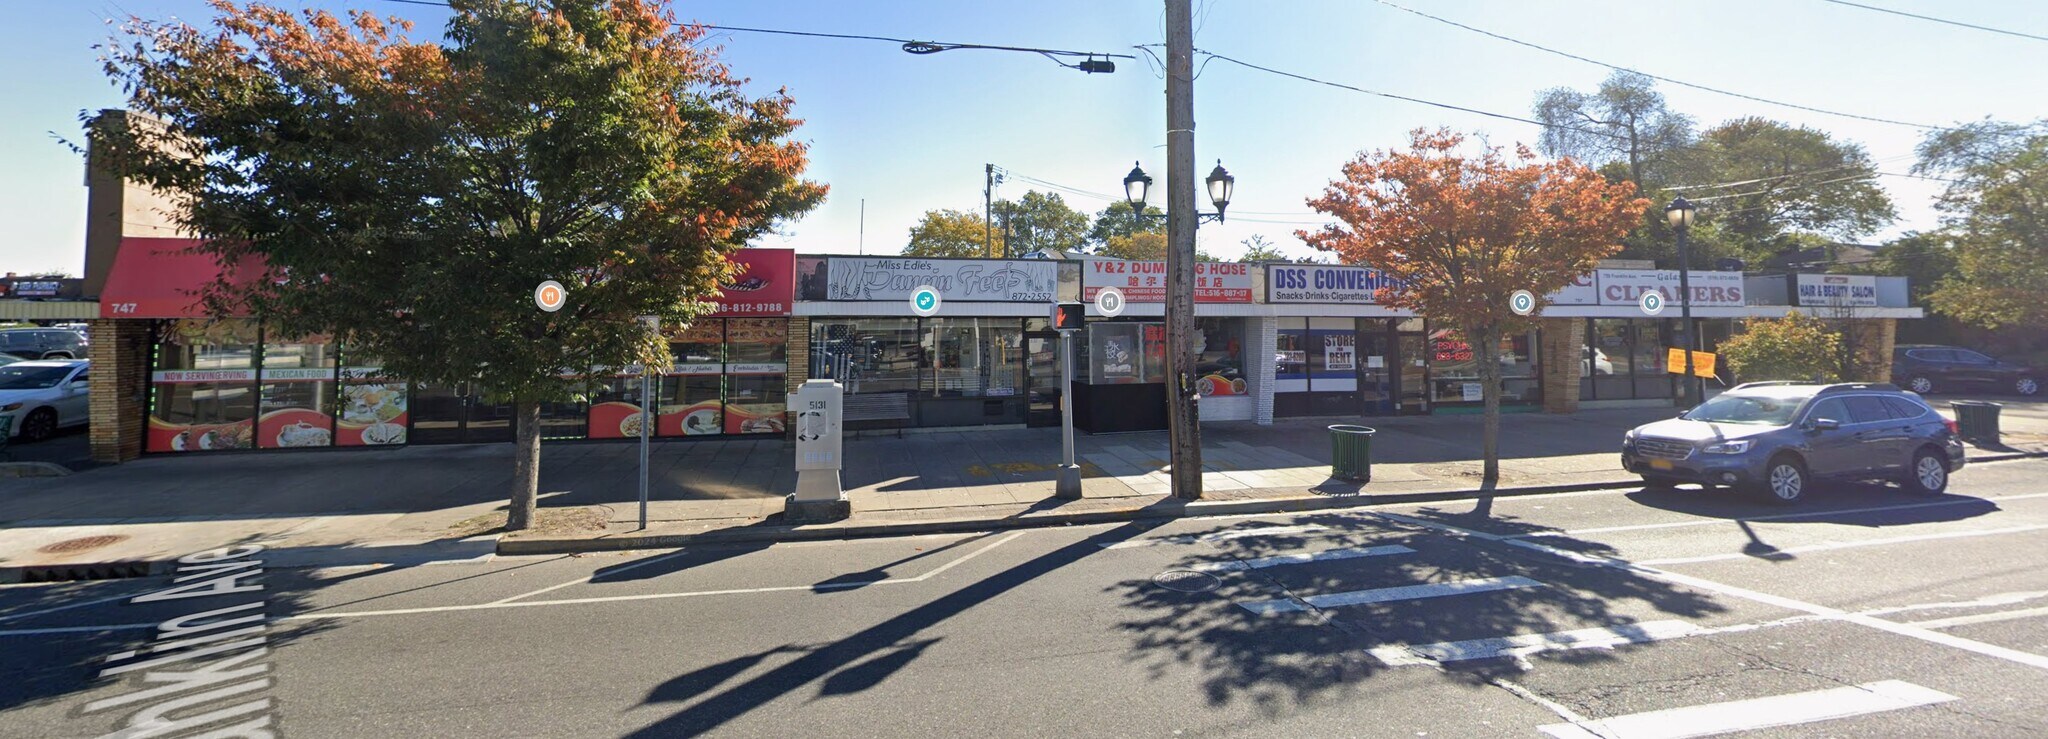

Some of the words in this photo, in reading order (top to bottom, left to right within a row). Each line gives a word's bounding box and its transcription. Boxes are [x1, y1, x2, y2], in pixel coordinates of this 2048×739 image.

[876, 260, 901, 270] Miss
[903, 261, 932, 270] Edie's
[956, 262, 1032, 299] Feet
[1275, 269, 1307, 289] DSS
[1276, 291, 1304, 300] Snacks
[1305, 292, 1330, 300] Drinks
[1331, 292, 1369, 302] Cigarettes
[1851, 286, 1875, 298] SALON
[112, 303, 136, 314] 747
[717, 302, 782, 312] 16-812-9788
[1325, 335, 1355, 347] STORE
[1329, 352, 1352, 363] RENT
[164, 372, 184, 380] NOW
[270, 370, 305, 378] MEXICAN
[307, 370, 327, 378] FOOD
[809, 401, 826, 410] 5131
